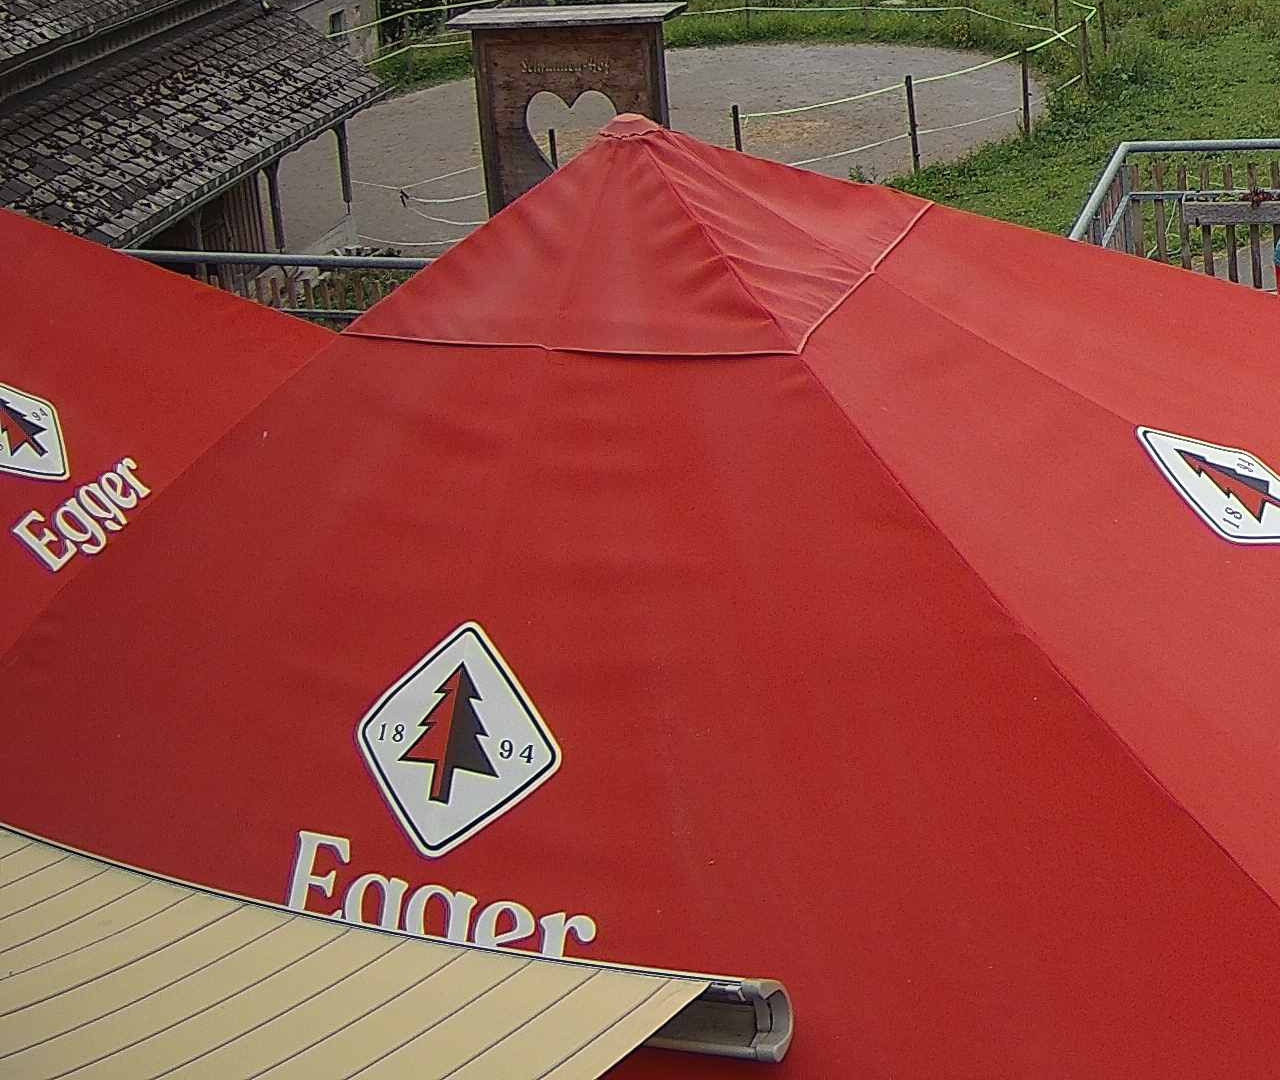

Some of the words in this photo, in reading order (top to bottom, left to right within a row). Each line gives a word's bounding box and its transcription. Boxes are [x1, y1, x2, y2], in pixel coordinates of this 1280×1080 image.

[12, 456, 151, 572] Egger
[376, 722, 406, 743] 18
[498, 739, 535, 765] 94
